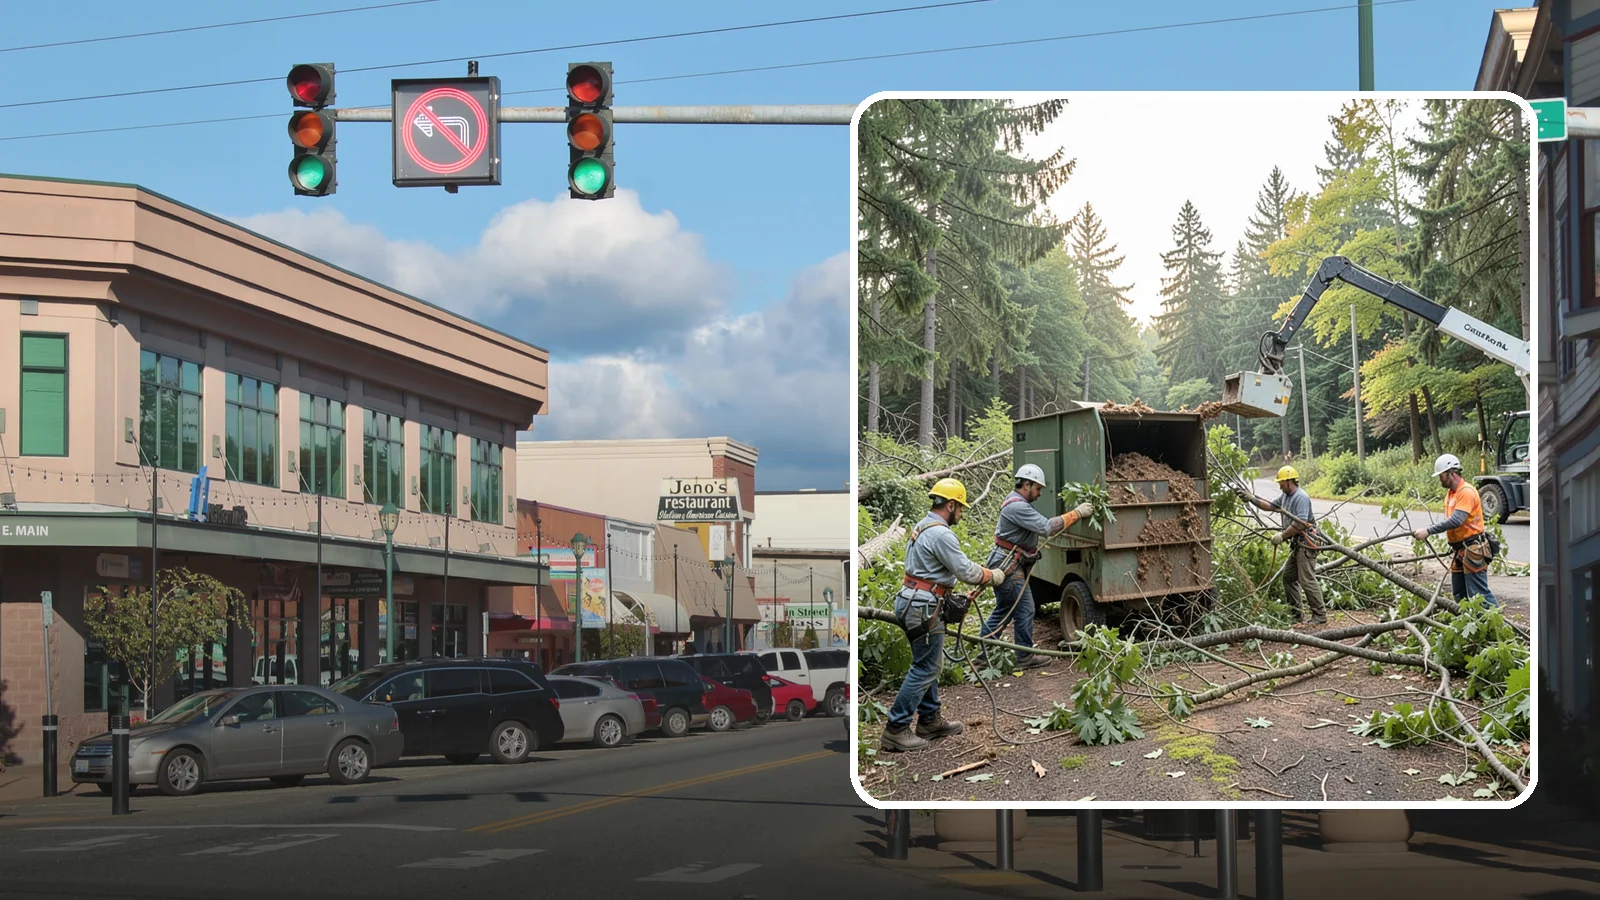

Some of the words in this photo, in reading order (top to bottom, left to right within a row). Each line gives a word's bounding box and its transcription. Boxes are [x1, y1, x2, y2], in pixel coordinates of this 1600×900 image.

[669, 480, 727, 494] Jeno's
[665, 496, 731, 509] restaurant
[686, 510, 714, 519] American
[715, 509, 737, 519] Cuisine
[2, 525, 13, 536] E.
[15, 525, 49, 536] MAIN
[797, 607, 828, 616] Street
